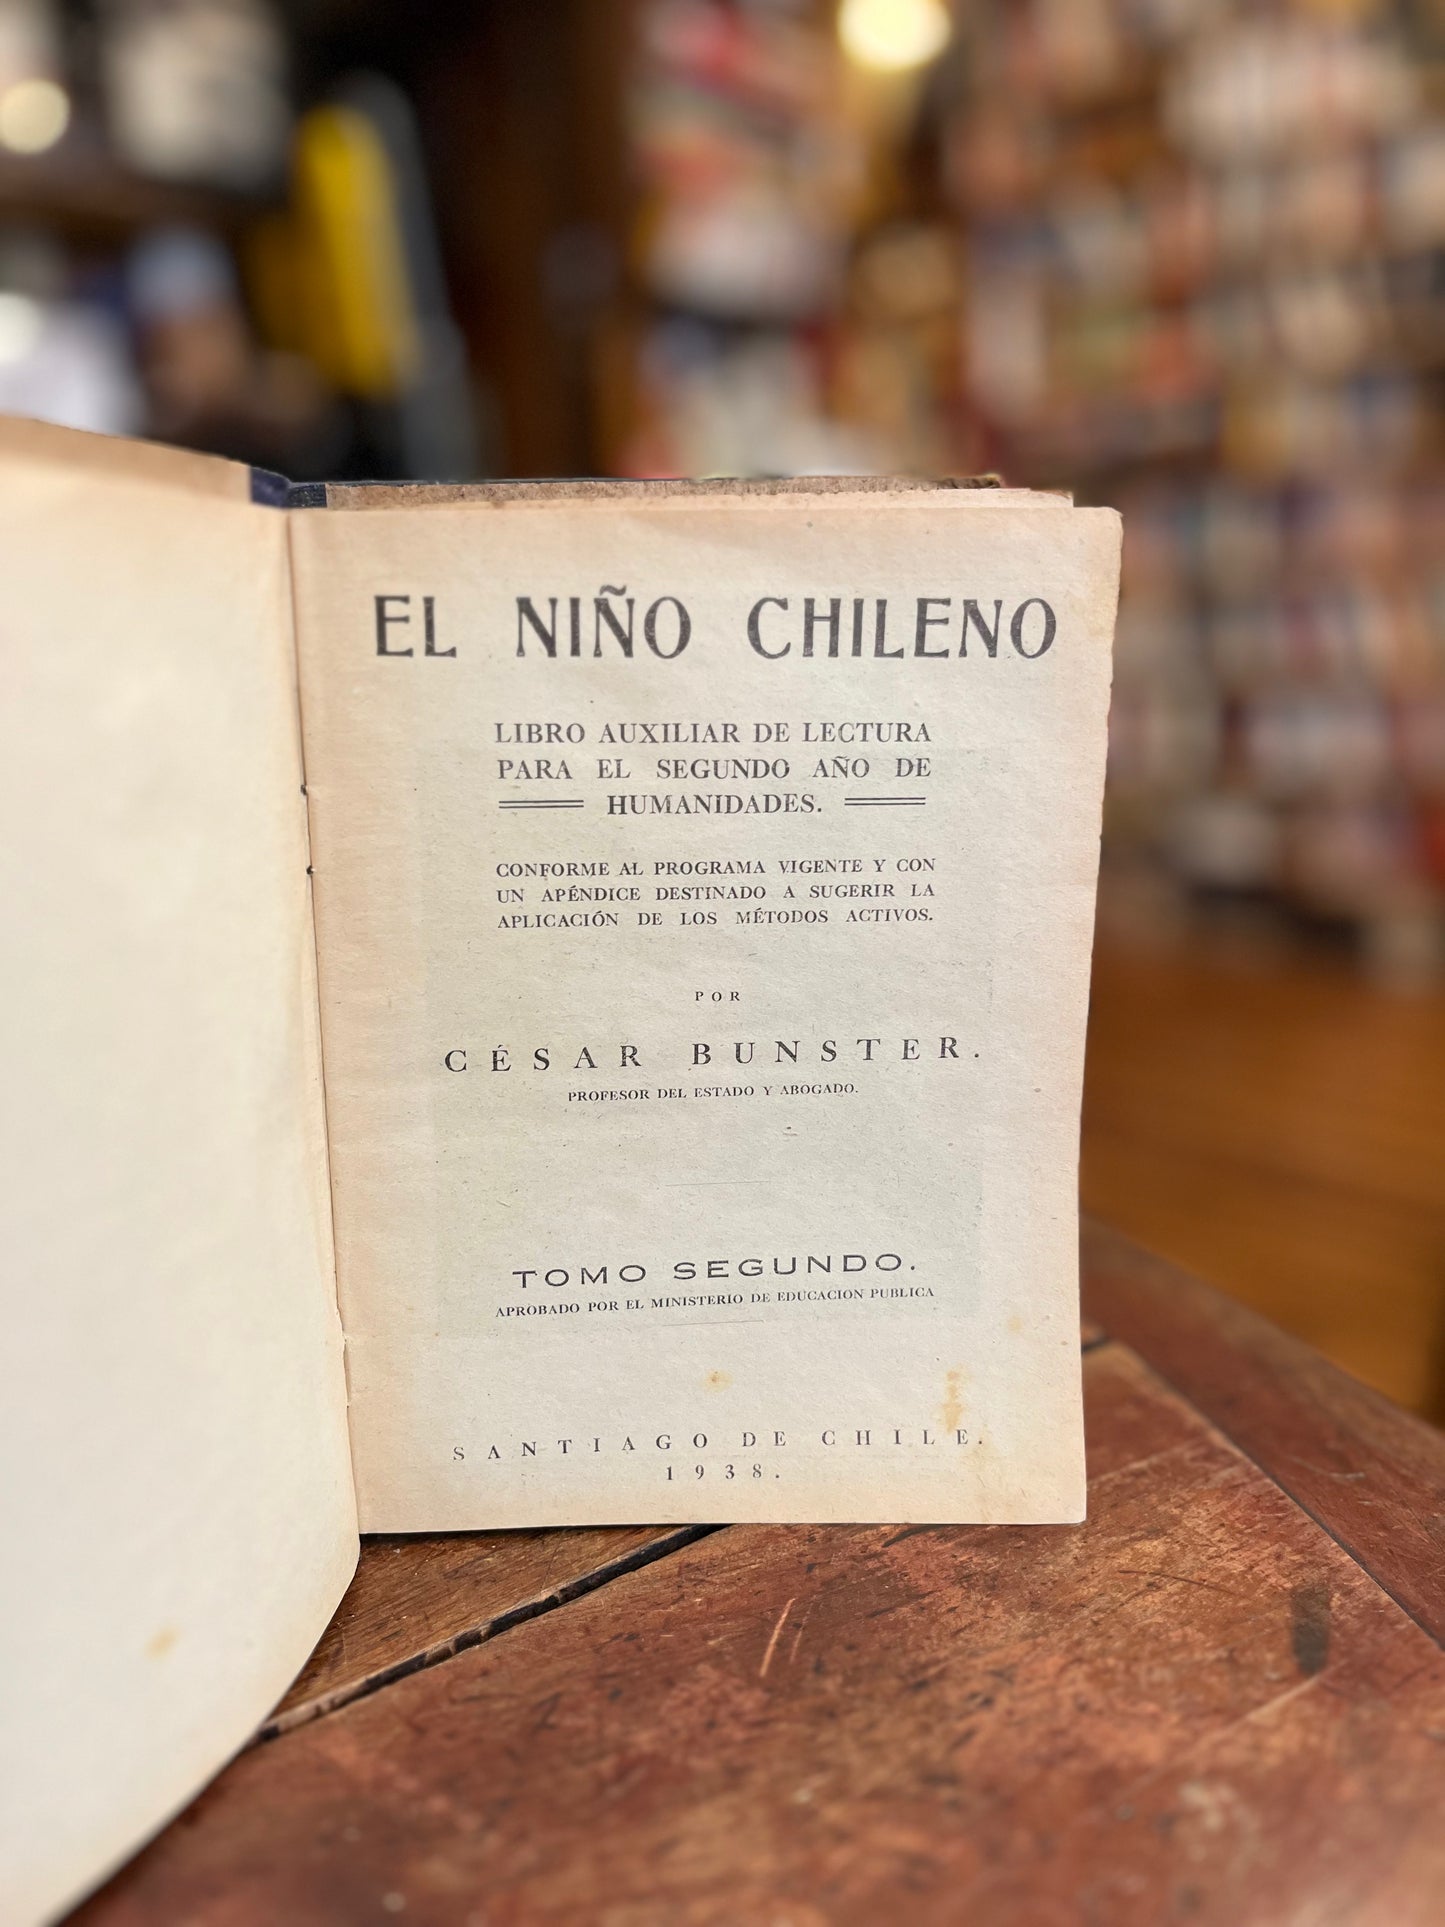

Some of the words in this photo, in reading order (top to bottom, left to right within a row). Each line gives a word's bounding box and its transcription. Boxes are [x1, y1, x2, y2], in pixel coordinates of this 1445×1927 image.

[373, 594, 457, 659] EL
[515, 584, 692, 660] NIÑO
[746, 596, 1057, 660] CHILENO
[494, 722, 586, 744] LIBRO
[598, 722, 741, 744] AUXILIAR
[752, 722, 791, 744] DE
[801, 721, 932, 744] LECTURA
[496, 759, 574, 780] PARA
[596, 758, 632, 779] EL
[656, 758, 791, 780] SEGUNDO
[811, 755, 870, 779] AÑO
[894, 757, 932, 778] DE
[606, 792, 823, 816] HUMANIDADES.
[495, 862, 611, 878] CONFORME
[618, 861, 645, 876] AL
[653, 860, 767, 876] PROGRAMA
[777, 858, 864, 875] VIGENTE
[872, 858, 887, 873] Y
[896, 857, 936, 873] CON
[496, 887, 525, 904] UN
[540, 884, 641, 903] APÉNDICE
[655, 885, 767, 901] DESTINADO
[782, 884, 796, 899] A
[808, 883, 896, 899] SUGERIR
[910, 883, 935, 897] LA
[497, 909, 620, 929] APLICACIÓN
[637, 912, 663, 926] DE
[679, 911, 718, 926] LOS
[735, 906, 829, 925] MÉTODOS
[845, 907, 934, 923] ACTIVOS.
[695, 990, 741, 1002] POR
[444, 1044, 643, 1073] CÉSAR
[691, 1036, 980, 1066] BUNSTER.
[568, 1089, 650, 1102] PROFESOR
[657, 1088, 687, 1099] DEL
[694, 1085, 755, 1098] ESTADO
[761, 1085, 774, 1096] Y
[779, 1083, 859, 1096] ABOGADO.
[511, 1264, 647, 1289] TOMO
[673, 1253, 916, 1281] SEGUNDO.
[495, 1302, 580, 1318] APROBADO
[588, 1300, 620, 1312] POR
[626, 1298, 645, 1310] EL
[650, 1293, 744, 1309] MINISTERIO
[750, 1292, 771, 1304] DE
[777, 1288, 865, 1302] EDUCACION
[870, 1287, 935, 1299] PUBLICA
[453, 1432, 708, 1461] SANTIAGO
[742, 1431, 787, 1448] DE
[821, 1428, 983, 1446] CHILE.
[666, 1463, 780, 1481] 1938.
